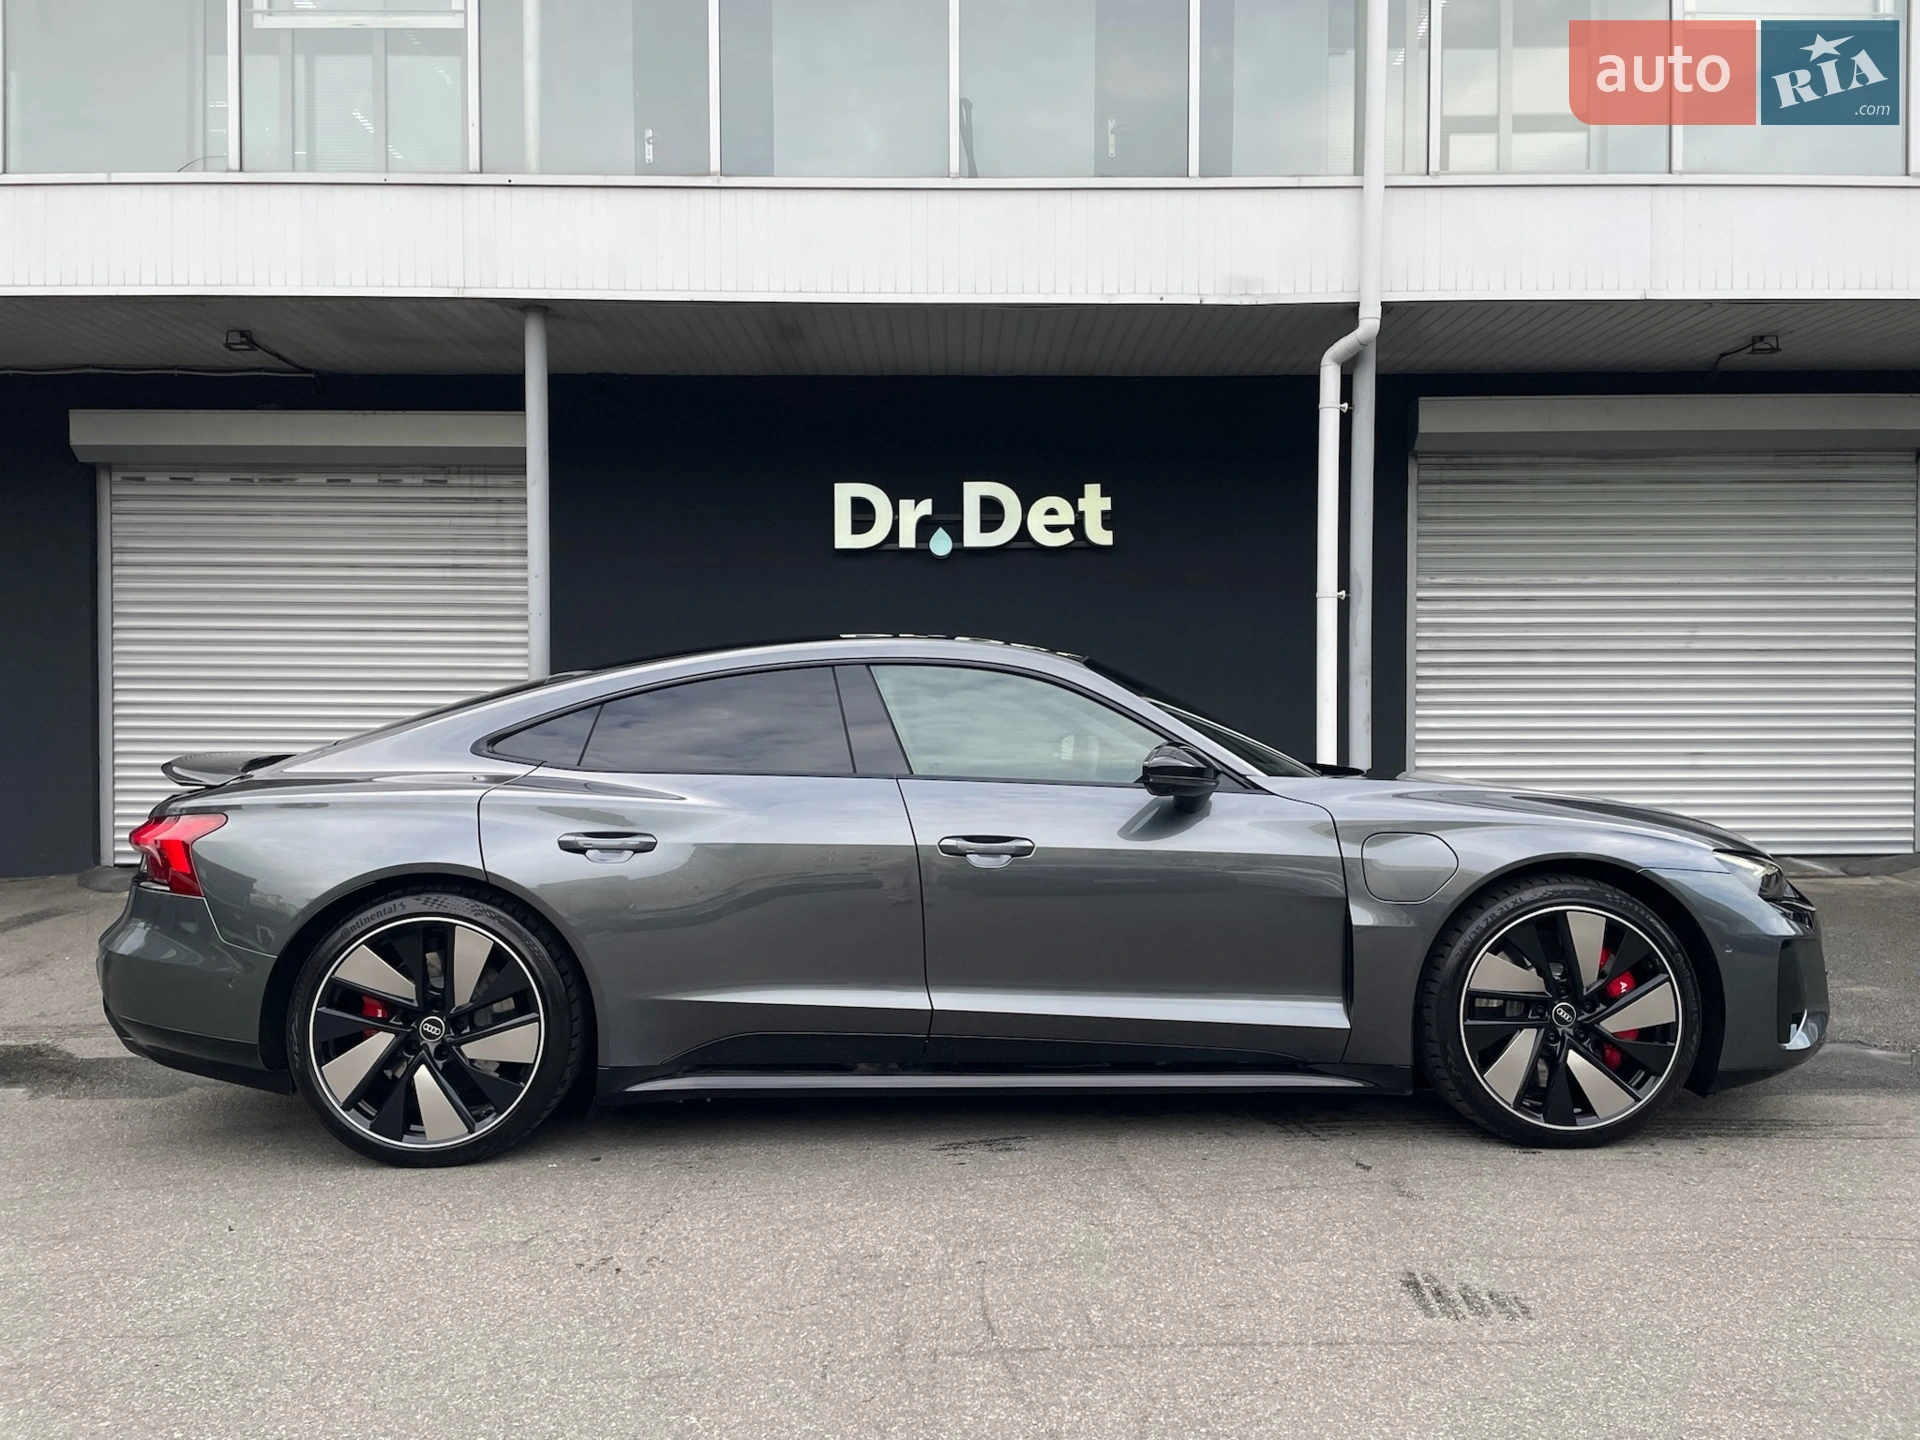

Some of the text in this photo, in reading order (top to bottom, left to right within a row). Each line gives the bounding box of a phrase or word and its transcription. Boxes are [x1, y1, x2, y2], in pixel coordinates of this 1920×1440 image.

[340, 902, 398, 938] Continental
[1497, 904, 1510, 916] 21
[1511, 897, 1526, 907] XL
